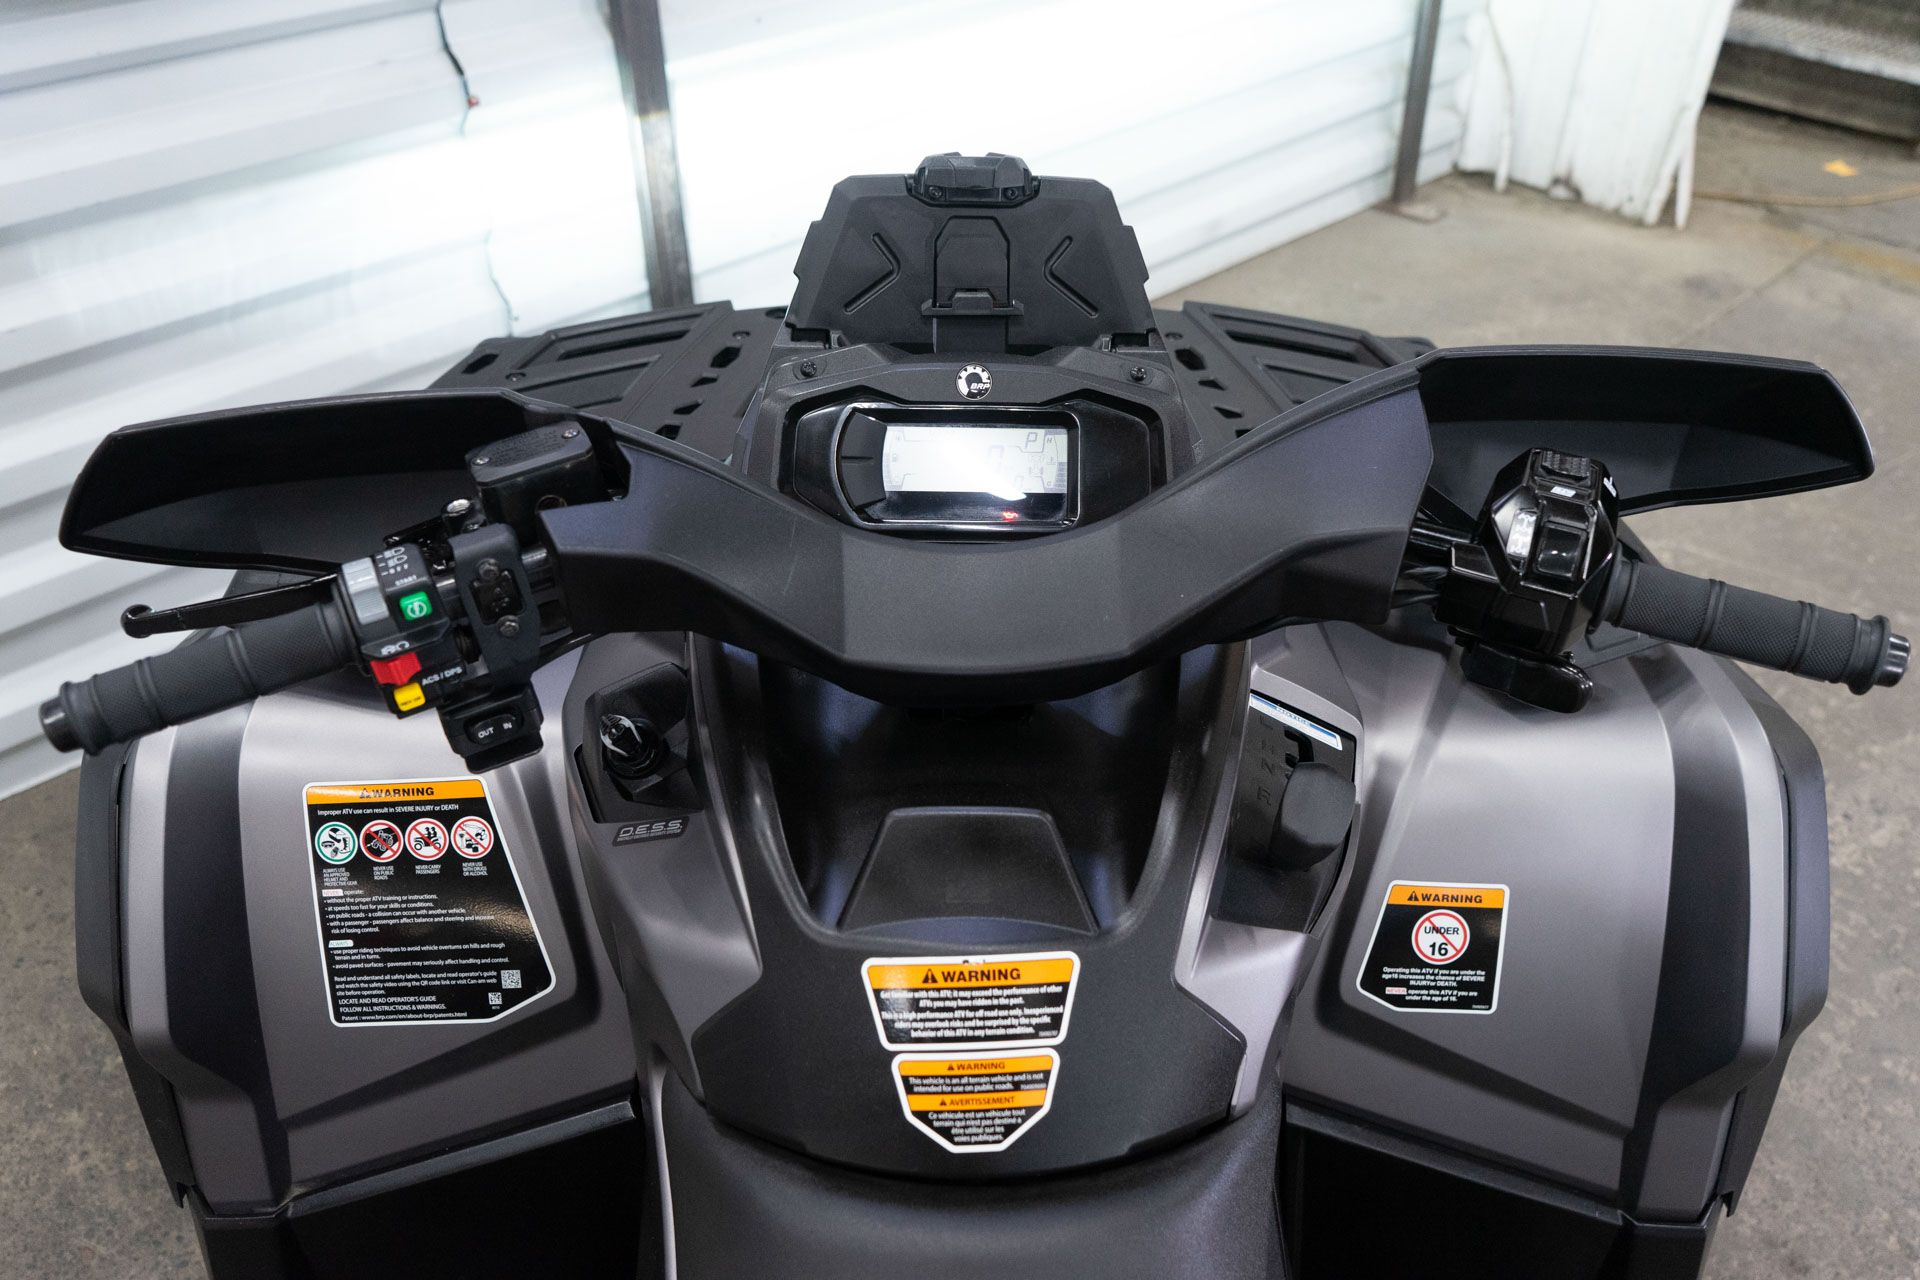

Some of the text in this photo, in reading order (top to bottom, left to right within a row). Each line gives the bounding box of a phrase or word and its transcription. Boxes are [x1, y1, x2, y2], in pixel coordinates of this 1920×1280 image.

[1025, 432, 1037, 448] P
[503, 722, 512, 730] IN
[478, 727, 494, 738] OUT
[372, 787, 435, 799] WARNING
[1422, 893, 1482, 904] WARNING
[1424, 926, 1460, 935] UNDER
[1429, 942, 1448, 956] 16
[942, 968, 1020, 982] WARNING
[957, 1062, 1005, 1070] WARNING
[943, 1084, 952, 1092] for
[974, 1084, 994, 1092] public
[949, 1096, 1015, 1106] AVERTISSEMENT
